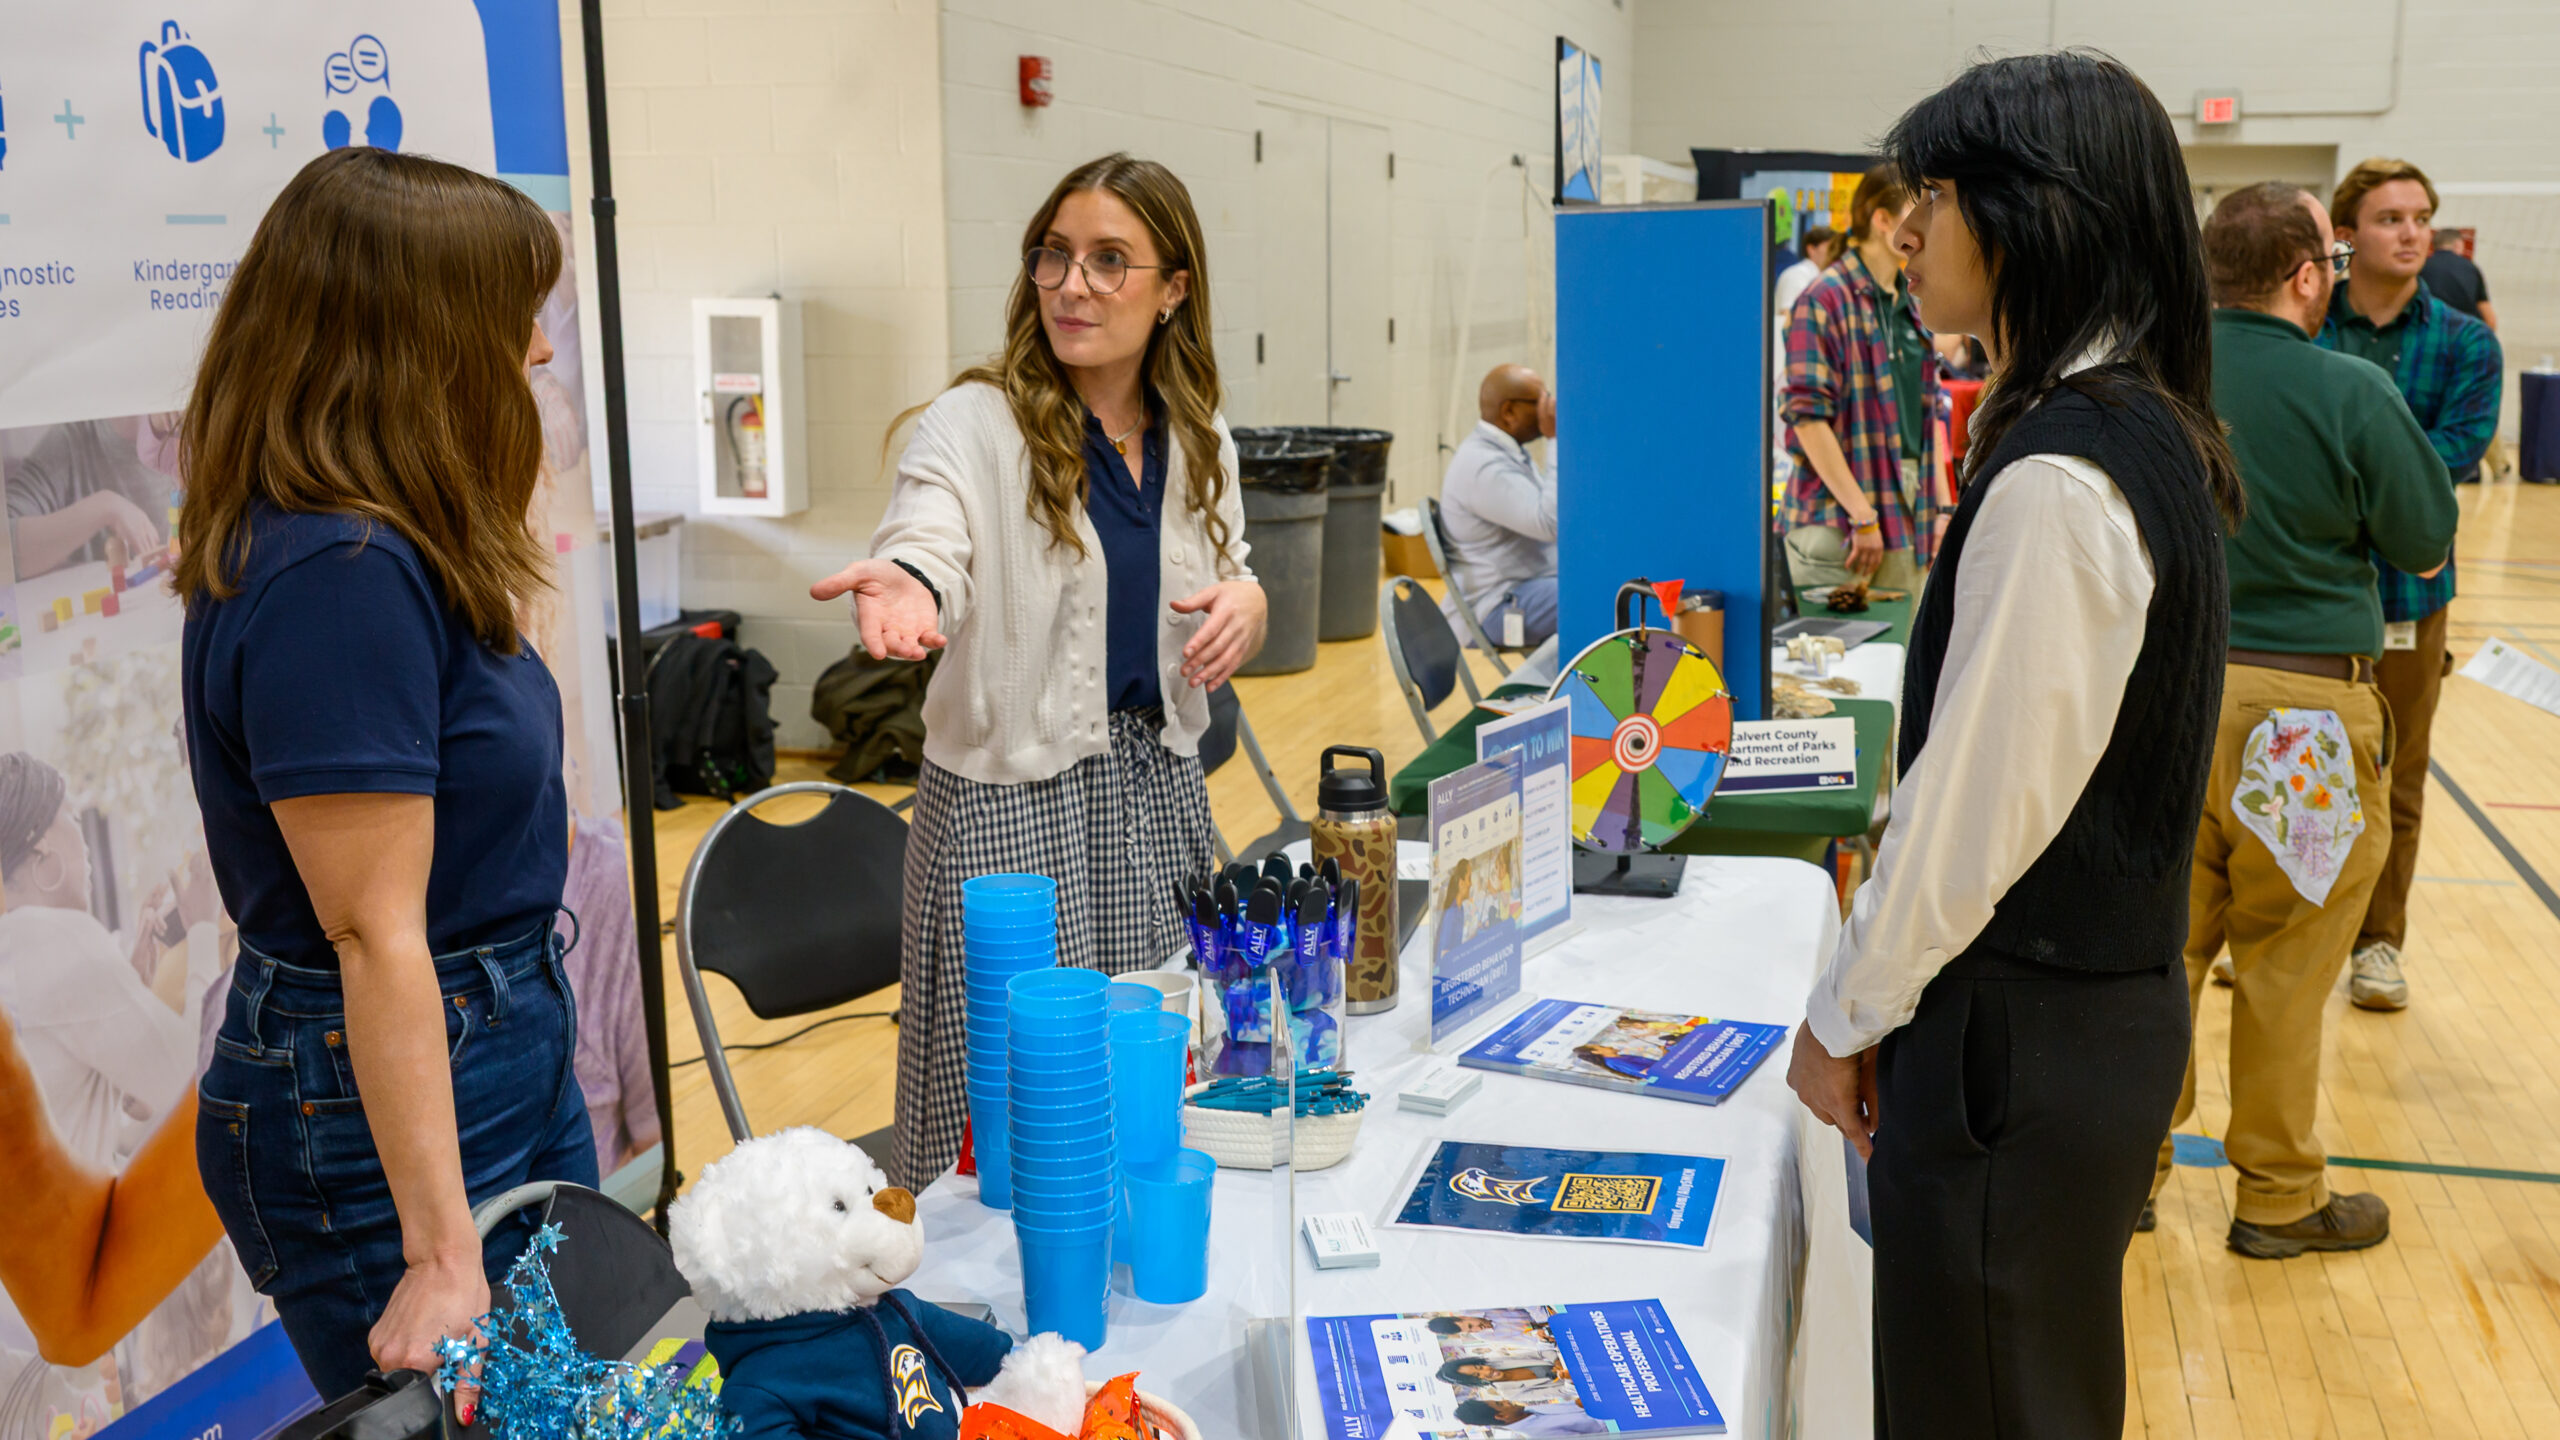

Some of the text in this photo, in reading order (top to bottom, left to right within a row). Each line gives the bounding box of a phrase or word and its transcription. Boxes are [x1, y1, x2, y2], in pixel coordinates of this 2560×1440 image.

[1774, 729, 1818, 741] County
[1787, 741, 1799, 752] of
[1803, 740, 1836, 751] Parks
[1755, 753, 1820, 766] Recreation
[1437, 789, 1453, 806] ALLY
[1203, 929, 1215, 961] ALLY
[1250, 926, 1263, 955] ALLY
[1304, 928, 1316, 957] ALLY
[1441, 962, 1481, 994] REGISTERED
[1482, 943, 1514, 971] BEHAVIOR
[1448, 959, 1508, 1006] TECHNICIAN (RBT)
[1674, 1051, 1712, 1080] REGISTERED
[1704, 1026, 1738, 1052] BEHAVIOR
[1696, 1047, 1736, 1077] TECHNICIAN
[1589, 1311, 1652, 1417] HEALTHCARE OPERATIONS
[1620, 1330, 1662, 1392] PROFESSIONAL
[1343, 1416, 1364, 1439] ALLY
